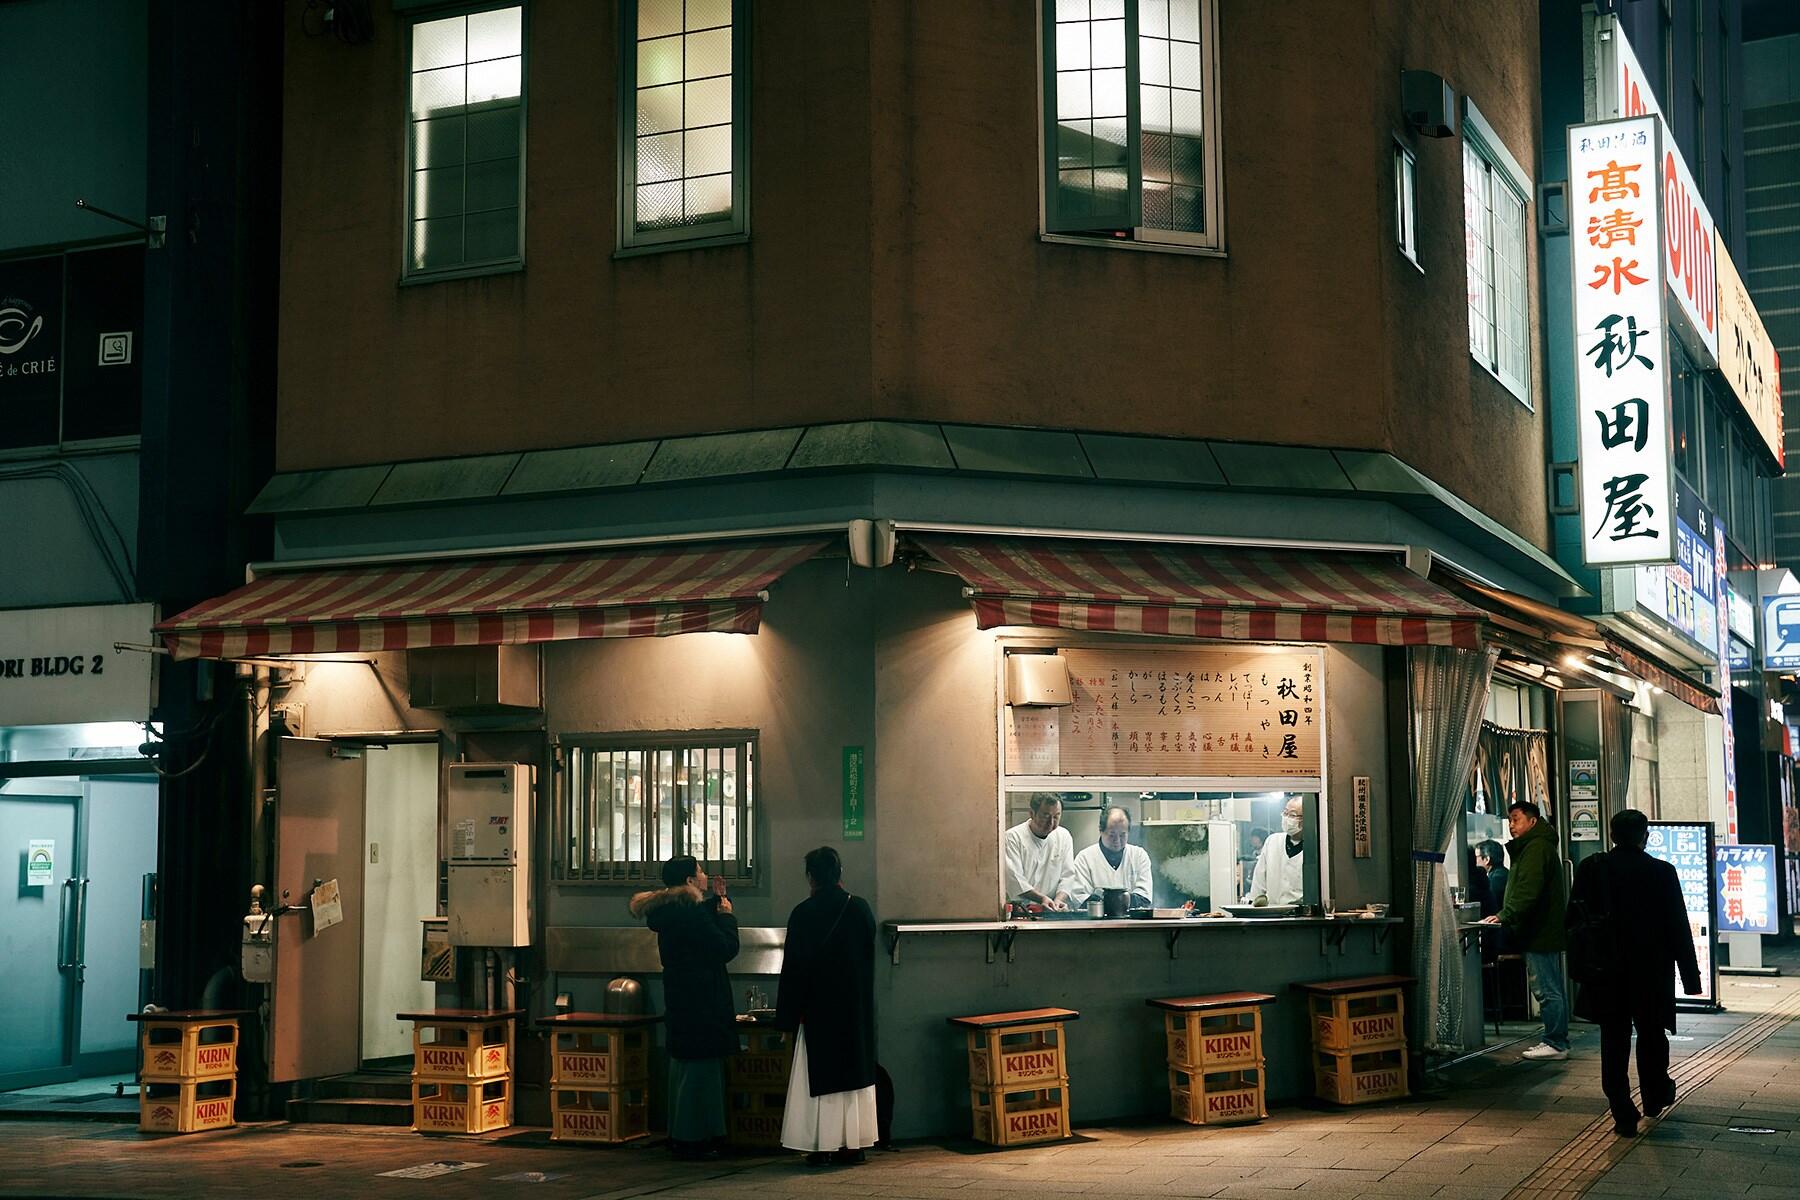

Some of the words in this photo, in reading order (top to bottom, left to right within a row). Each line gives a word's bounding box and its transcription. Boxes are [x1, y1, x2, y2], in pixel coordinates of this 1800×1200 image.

[1586, 313, 1660, 542] 秋田屋
[30, 655, 84, 678] BLDG
[90, 654, 104, 675] 2
[1128, 669, 1138, 705] かしら
[1186, 671, 1196, 711] なんこつ
[1200, 672, 1210, 702] はつ
[1214, 672, 1224, 702] たん
[1302, 662, 1313, 726] 創業昭和四年
[1260, 672, 1271, 759] もつやき
[1277, 677, 1300, 759] 秋田屋
[1716, 848, 1768, 862] カラオケ
[1727, 868, 1744, 921] 無料
[1352, 1017, 1394, 1036] KIRIN
[1206, 1035, 1250, 1054] KIRIN
[199, 1048, 231, 1064] KIRIN
[423, 1050, 465, 1065] KIRIN
[562, 1056, 606, 1072] KIRIN
[1006, 1052, 1054, 1072] KIRIN
[1356, 1072, 1398, 1090] KIRIN
[196, 1101, 229, 1119] KIRIN
[423, 1105, 465, 1120] KIRIN
[1208, 1093, 1254, 1112] KIRIN
[563, 1114, 607, 1130] KIRIN
[1010, 1112, 1058, 1132] KIRIN
